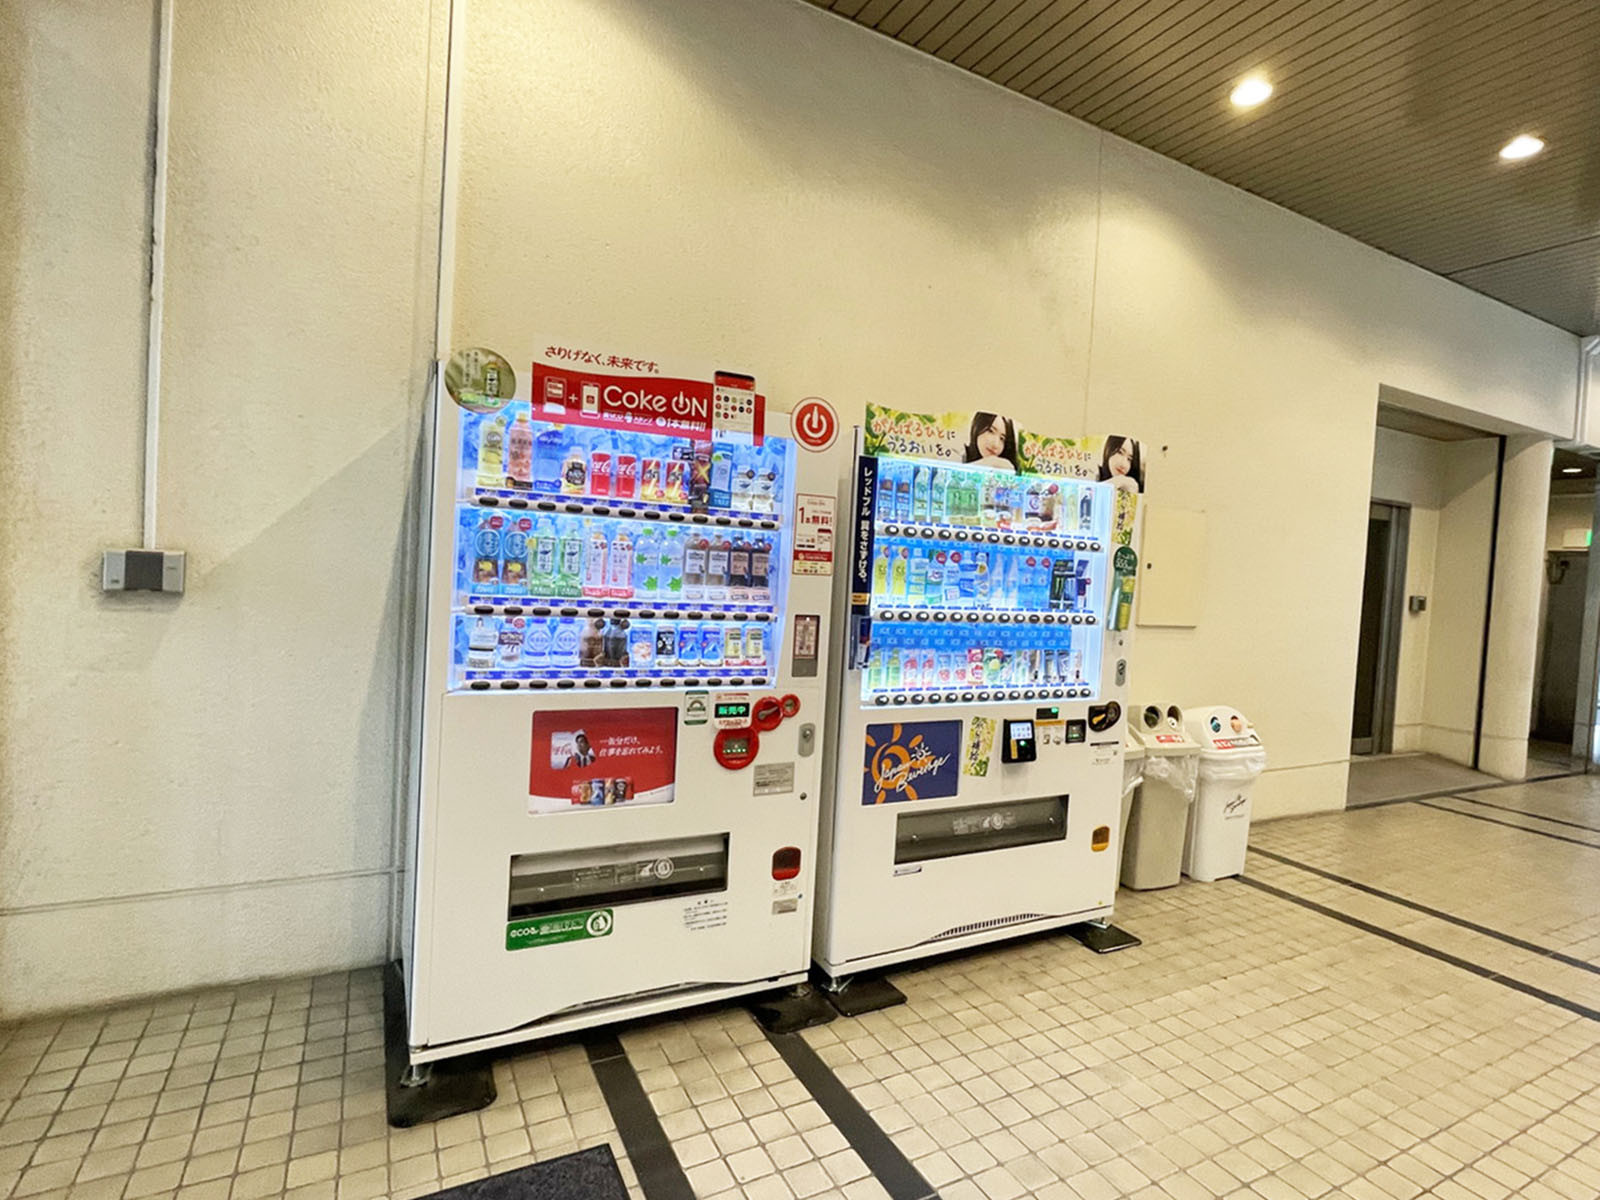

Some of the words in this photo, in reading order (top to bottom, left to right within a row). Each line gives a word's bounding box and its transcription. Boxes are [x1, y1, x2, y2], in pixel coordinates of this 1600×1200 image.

[545, 346, 660, 374] さりげなく、未来です。
[603, 385, 668, 413] Coke
[671, 391, 708, 418] ON
[873, 420, 956, 440] がんばるひとに
[886, 435, 952, 457] うるおいを。
[861, 467, 873, 516] レッドブル
